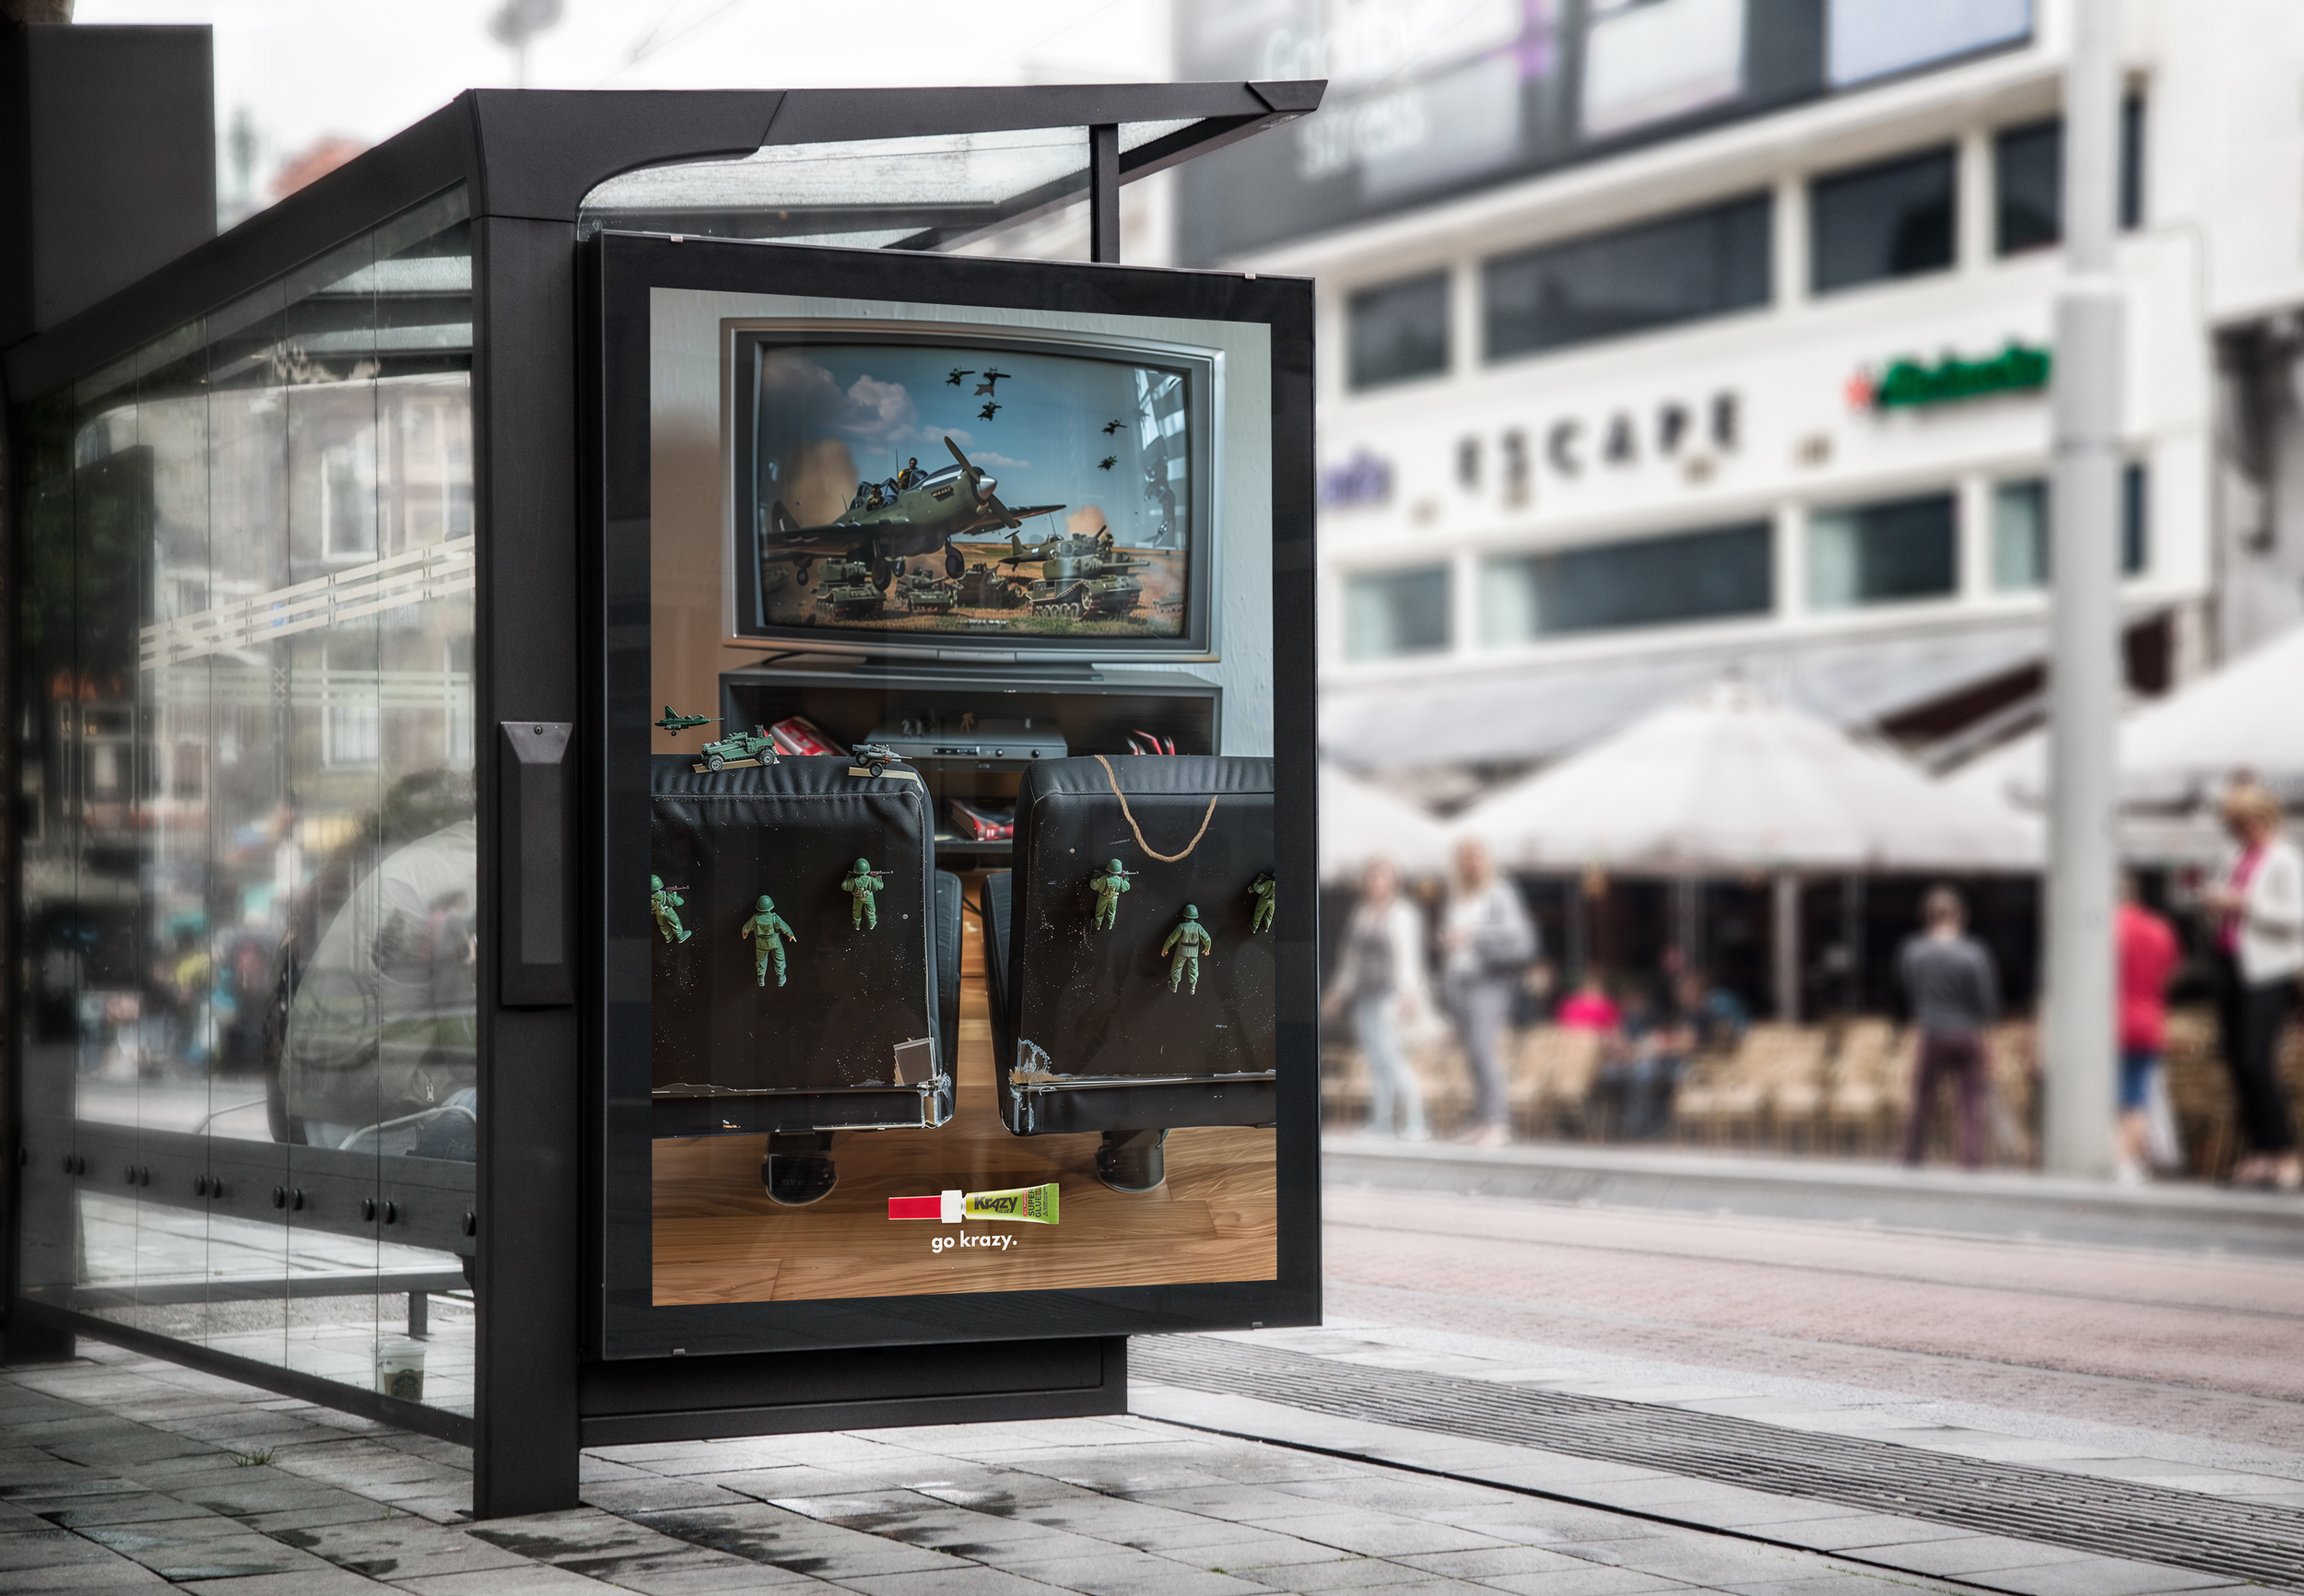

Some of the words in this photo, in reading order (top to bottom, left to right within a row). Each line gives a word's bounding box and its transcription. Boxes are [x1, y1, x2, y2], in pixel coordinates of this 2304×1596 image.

[1455, 391, 1741, 489] ESCAPE
[931, 1237, 955, 1253] go
[960, 1230, 1017, 1250] krazy.
